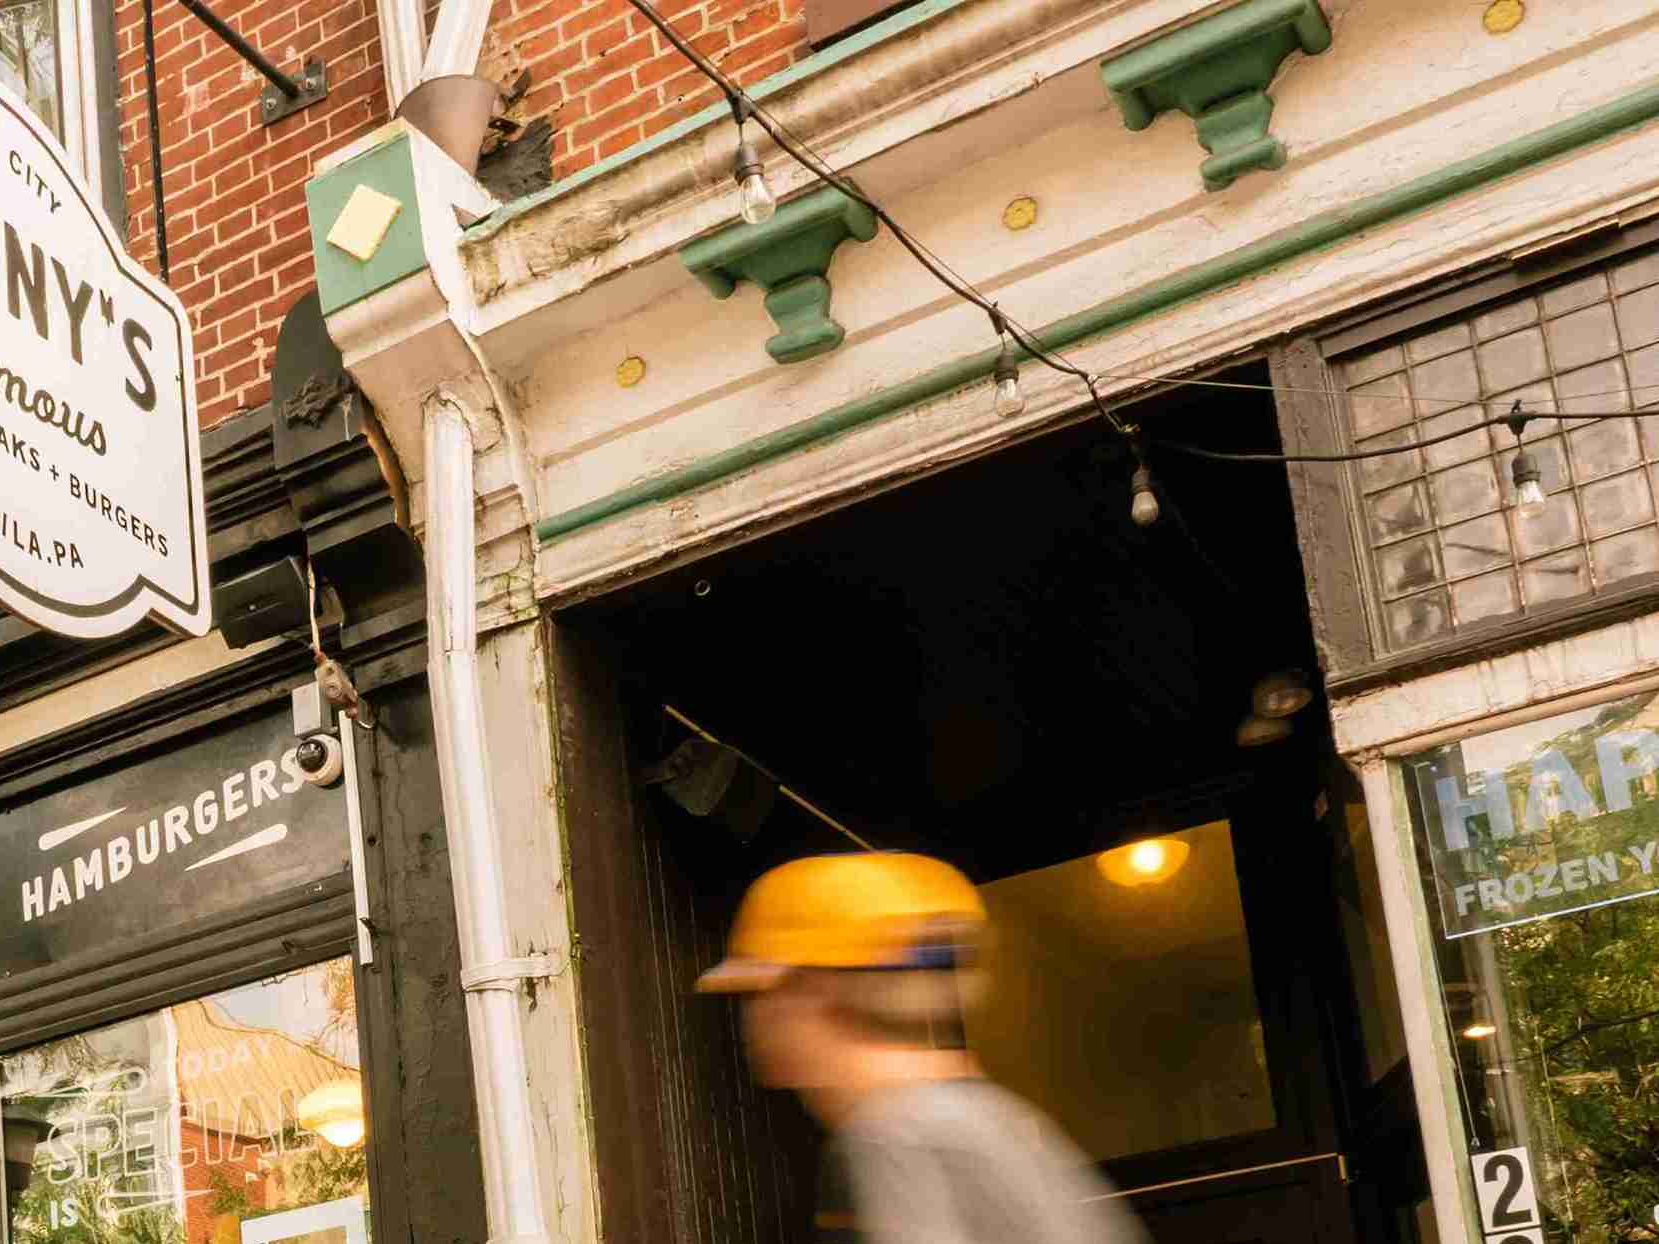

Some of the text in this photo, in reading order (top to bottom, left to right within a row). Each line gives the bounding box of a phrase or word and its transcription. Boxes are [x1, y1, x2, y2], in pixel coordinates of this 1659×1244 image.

[9, 148, 63, 215] CITY
[69, 474, 170, 558] BURGERS
[22, 748, 304, 923] HAMBURGERS
[1455, 855, 1620, 917] FROZEN
[47, 1087, 318, 1185] SPECIAL
[50, 1198, 79, 1230] IS
